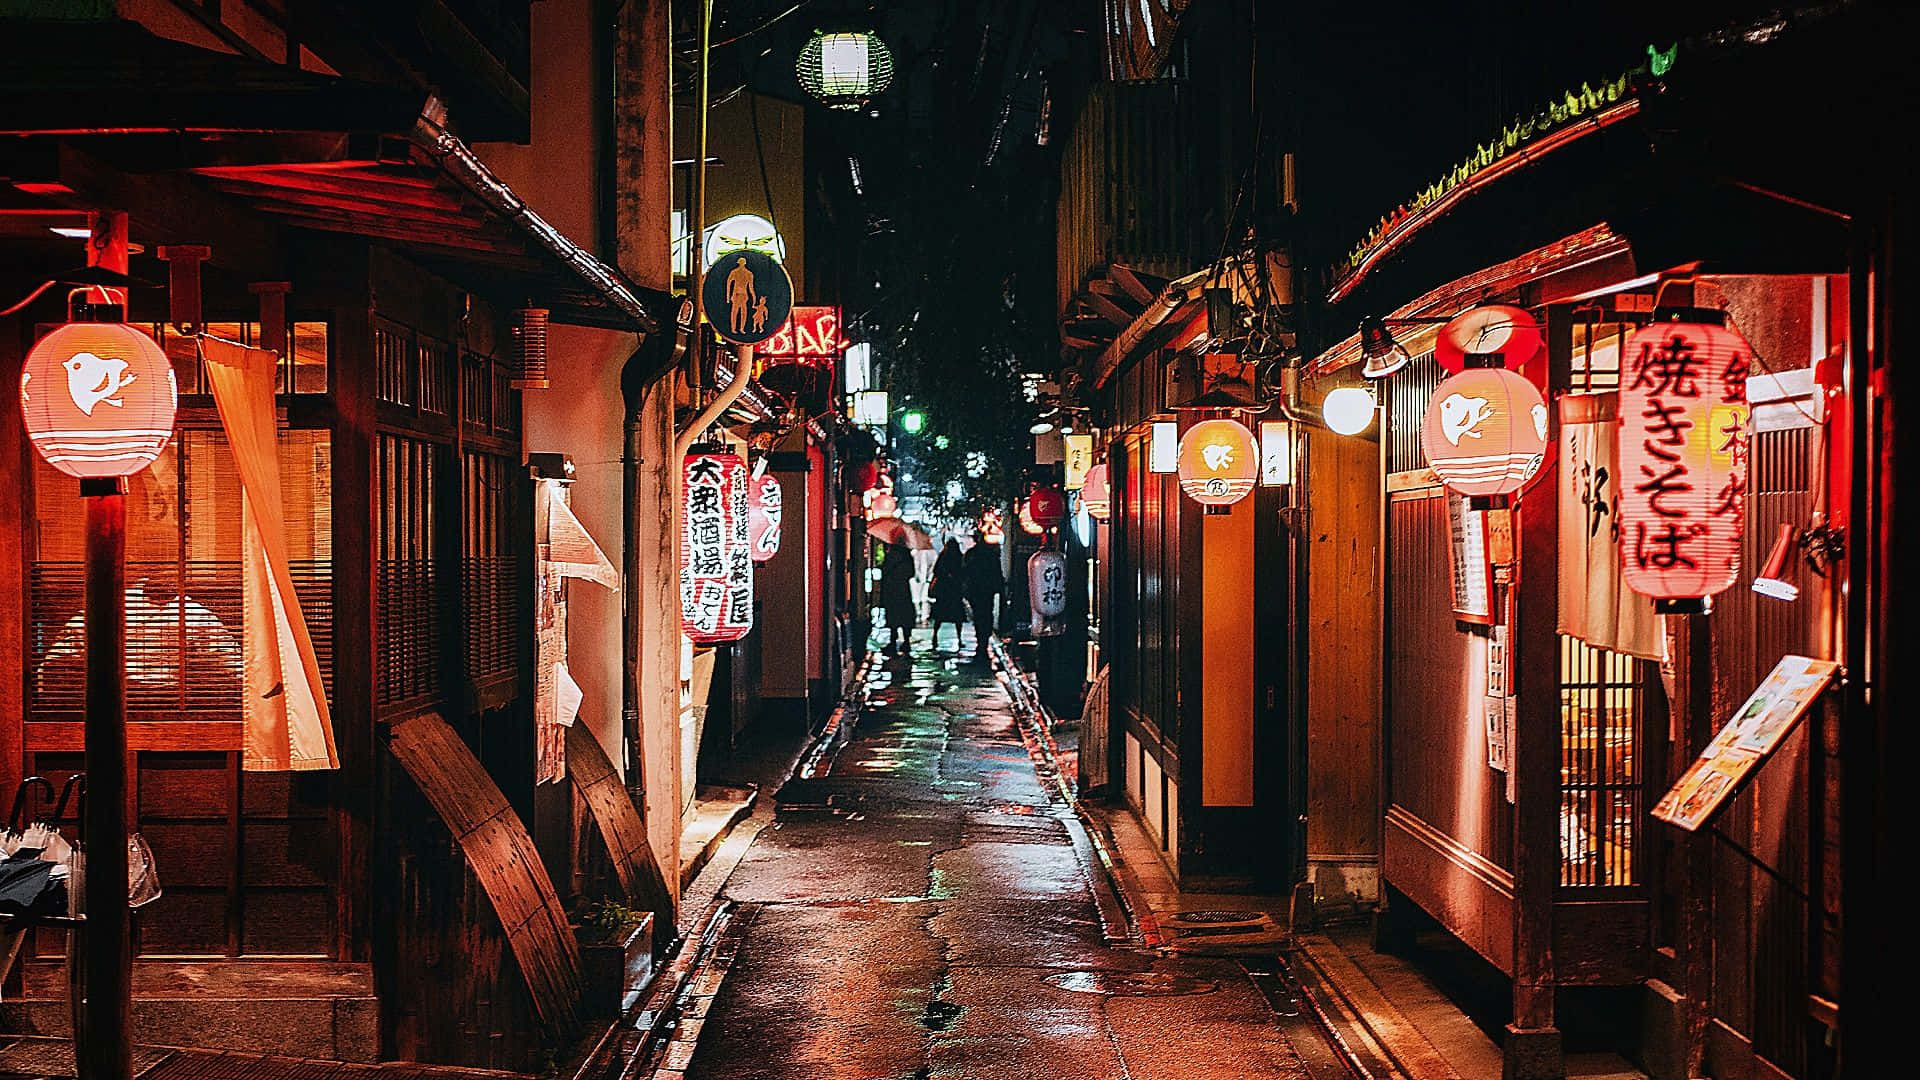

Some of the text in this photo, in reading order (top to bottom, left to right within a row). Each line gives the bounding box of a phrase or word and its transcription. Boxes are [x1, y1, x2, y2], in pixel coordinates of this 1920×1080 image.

[765, 315, 849, 355] BAR
[1630, 336, 1706, 570] 焼きそば
[689, 458, 724, 576] 大衆酒場
